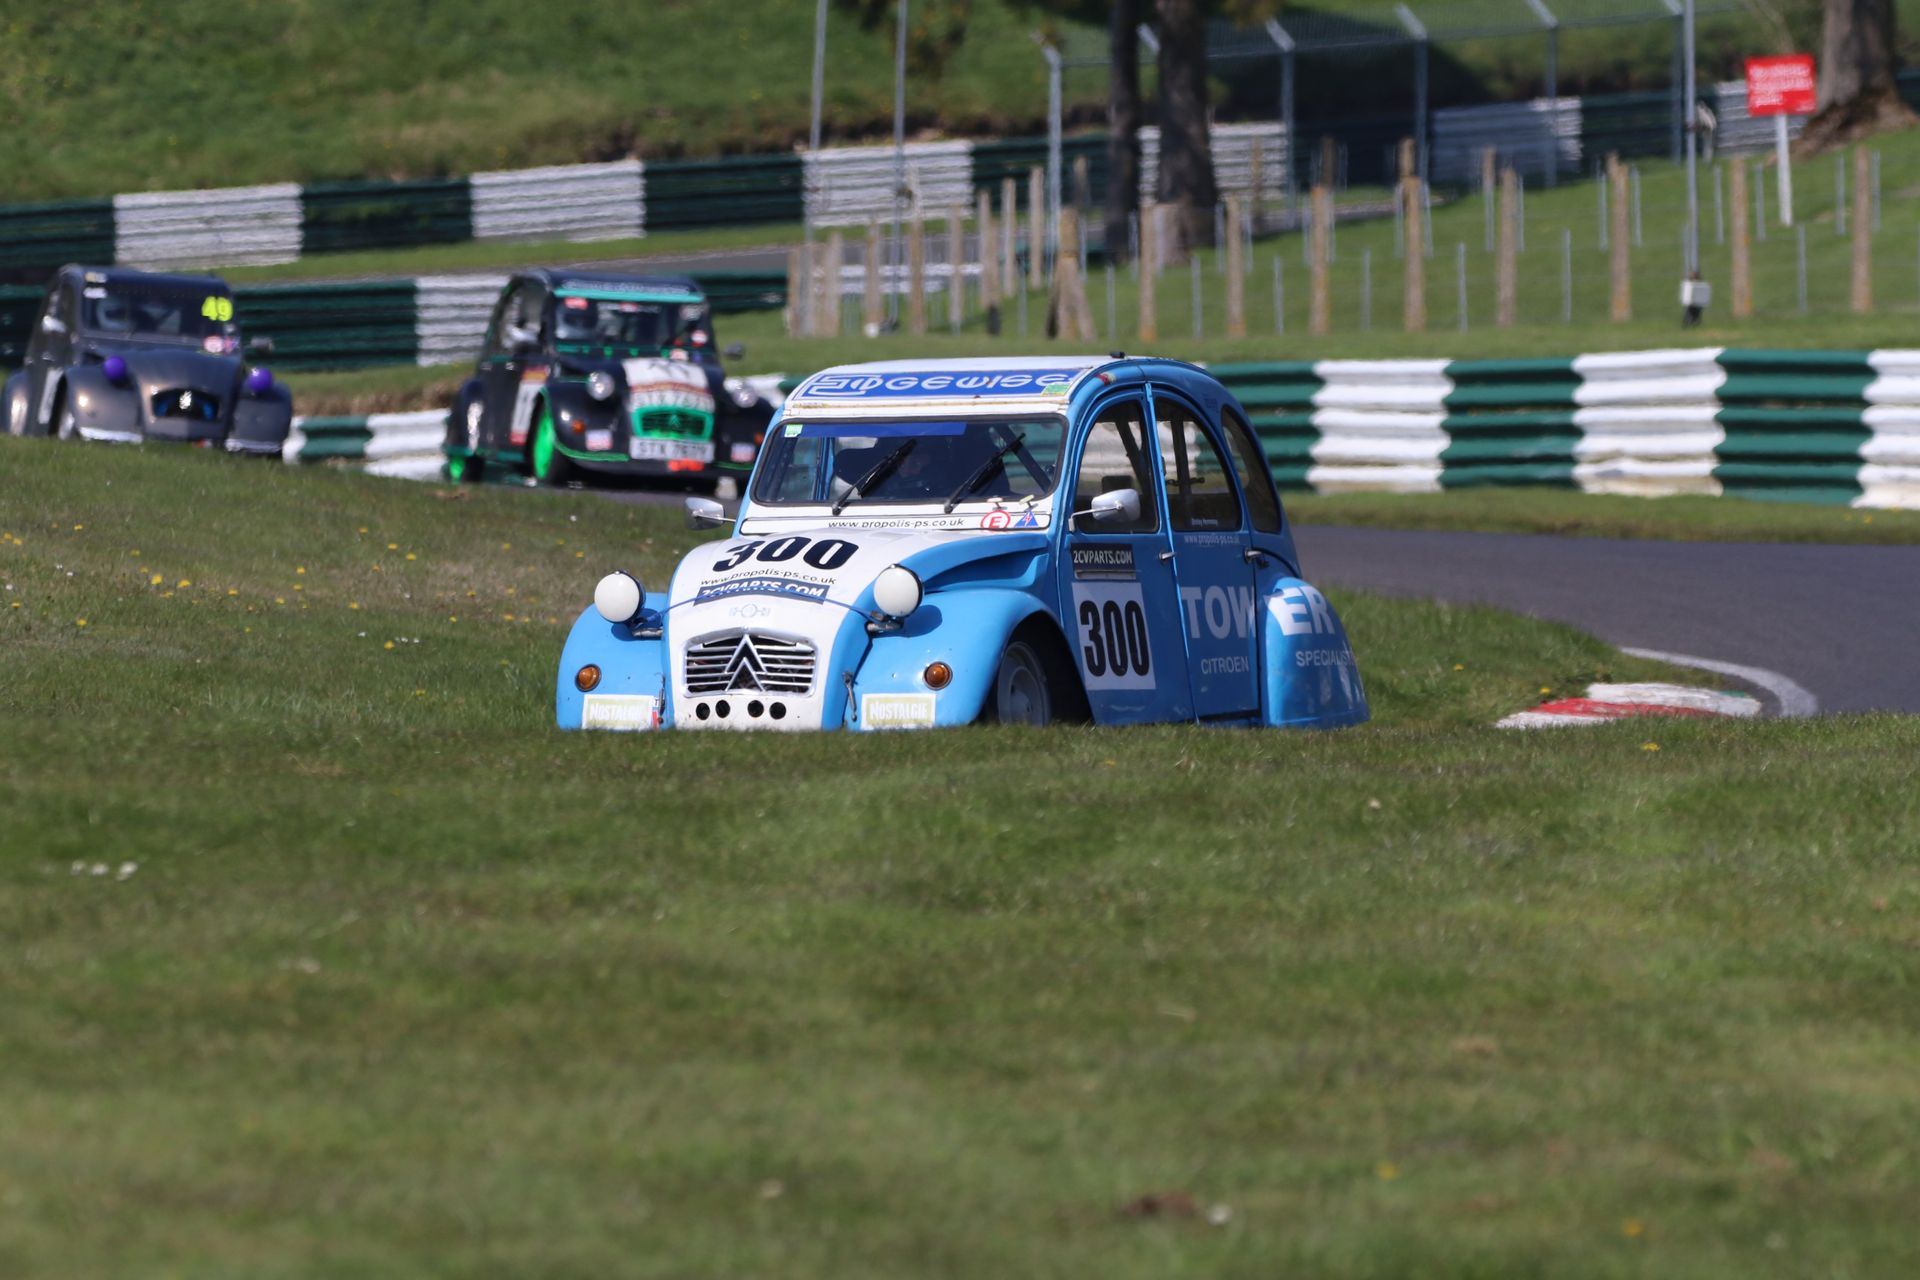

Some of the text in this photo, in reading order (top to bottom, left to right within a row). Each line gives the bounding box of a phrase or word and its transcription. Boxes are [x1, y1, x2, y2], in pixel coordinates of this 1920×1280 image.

[201, 295, 233, 322] 49
[712, 536, 859, 572] 300
[1073, 549, 1133, 564] 2CVPARTS.COM
[701, 568, 837, 585] www.propolis-ps.co.uk
[1180, 584, 1336, 640] TOWER
[1079, 600, 1150, 677] 300
[1201, 656, 1249, 675] CITROEN
[870, 702, 928, 720] NOSTALGIE
